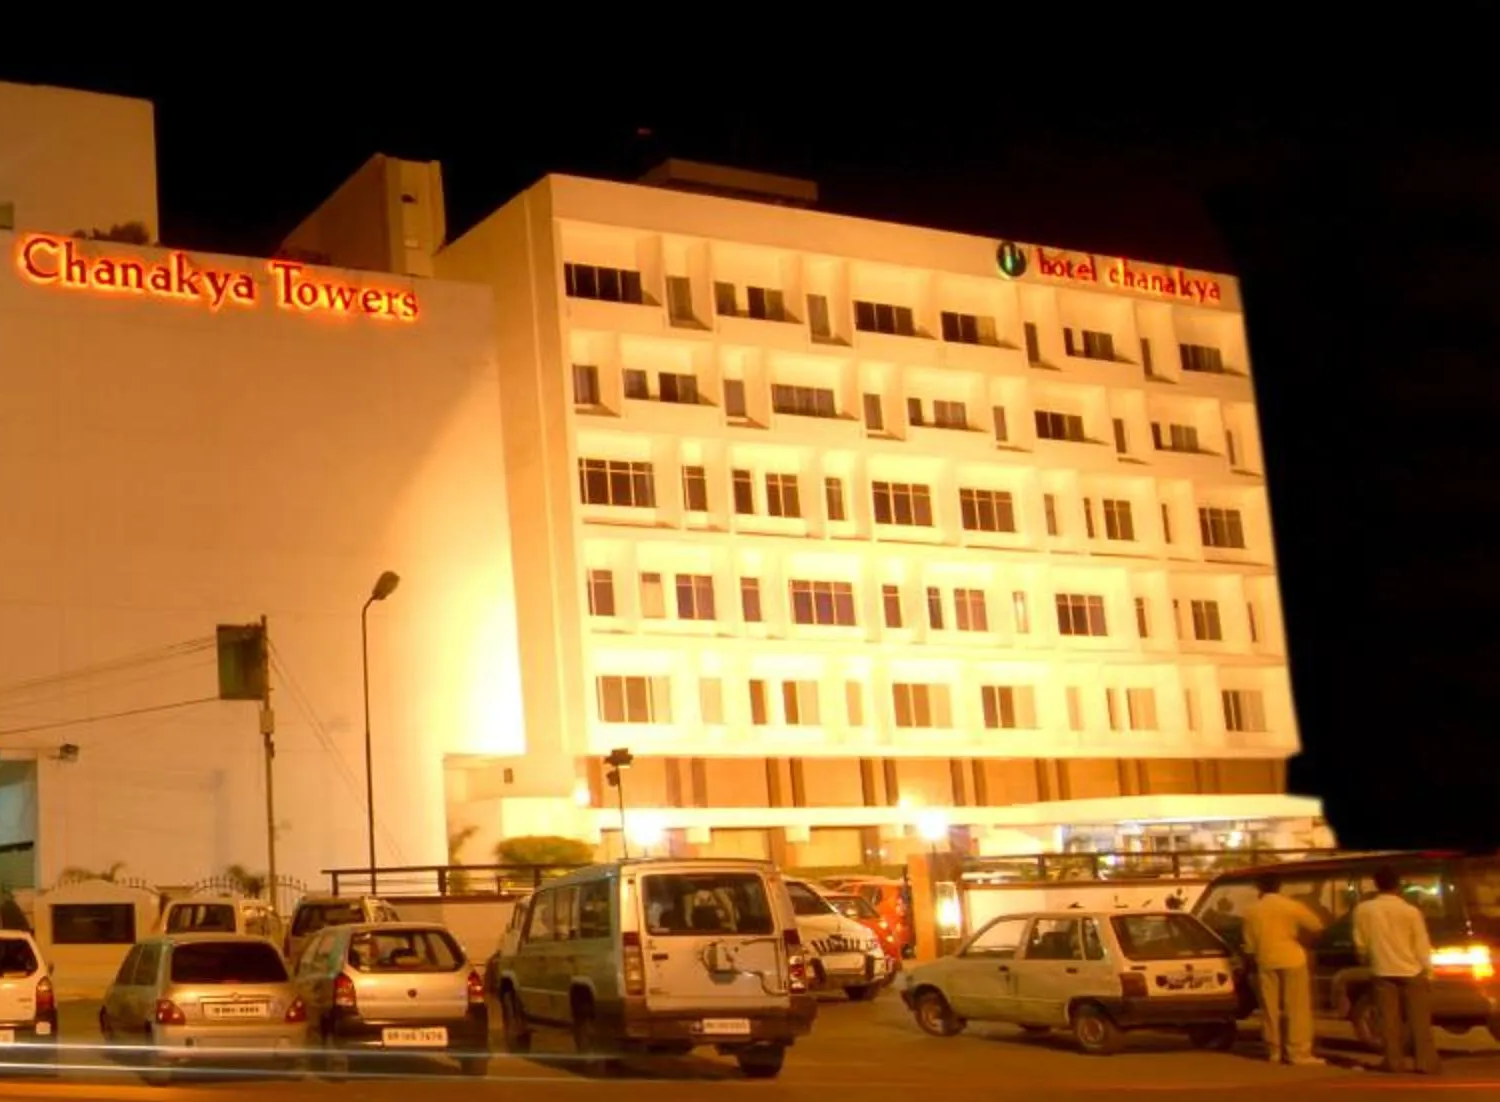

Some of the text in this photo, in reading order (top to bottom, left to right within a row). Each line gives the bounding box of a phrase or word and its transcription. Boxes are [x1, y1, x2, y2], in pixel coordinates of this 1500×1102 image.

[21, 236, 420, 320] Chanakya Towers
[1037, 247, 1222, 303] hotel chanakya
